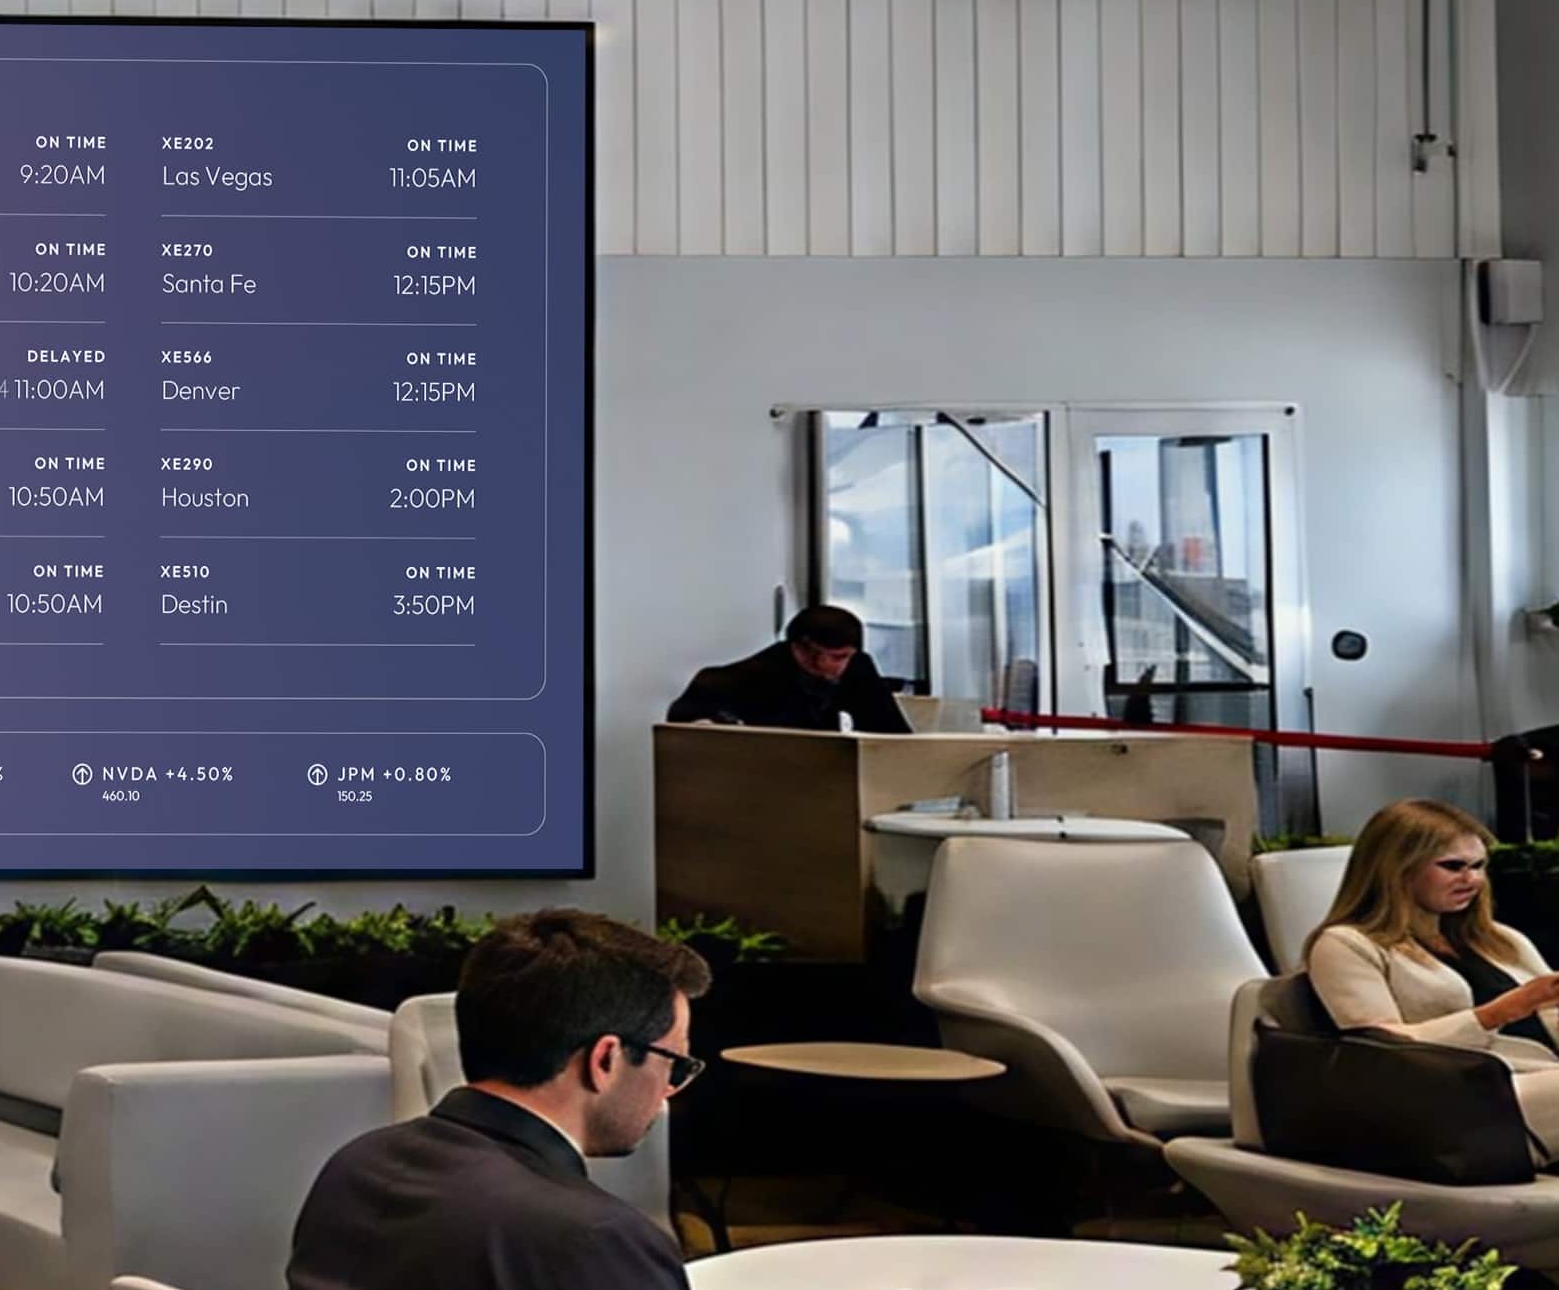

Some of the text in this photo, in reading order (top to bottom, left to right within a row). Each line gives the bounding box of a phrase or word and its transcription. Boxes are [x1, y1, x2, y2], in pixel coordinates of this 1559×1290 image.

[36, 136, 59, 148] ON
[67, 136, 105, 148] TIME
[163, 137, 476, 152] XE202 ON TIME
[21, 165, 104, 184] 9:20AM
[164, 166, 475, 191] Las Vegas 11:05AM
[36, 243, 58, 255] ON
[66, 243, 105, 255] TIME
[162, 244, 476, 258] XE270 ON TIME
[10, 272, 104, 292] 10:20AM
[163, 273, 475, 295] Santa Fe 12:15PM
[28, 350, 105, 362] DELAYED
[162, 351, 475, 365] XE566 ON TIME
[15, 380, 103, 399] 11:00AM
[163, 381, 474, 401] Denver 12:15PM
[35, 457, 58, 469] ON
[65, 457, 104, 469] TIME
[161, 458, 475, 471] XE290 ON TIME
[9, 487, 103, 506] 10:50AM
[163, 487, 474, 508] Houston 2:00PM
[34, 565, 56, 577] ON
[64, 565, 103, 577] TIME
[161, 566, 475, 579] XE510 ON TIME
[7, 594, 101, 613] 10:50AM
[163, 595, 473, 615] Destin 3:50PM
[103, 767, 232, 781] NVDA +4.50%
[338, 767, 451, 781] JPM +0.80%
[102, 791, 139, 801] 460.10
[338, 791, 372, 802] 150.25
